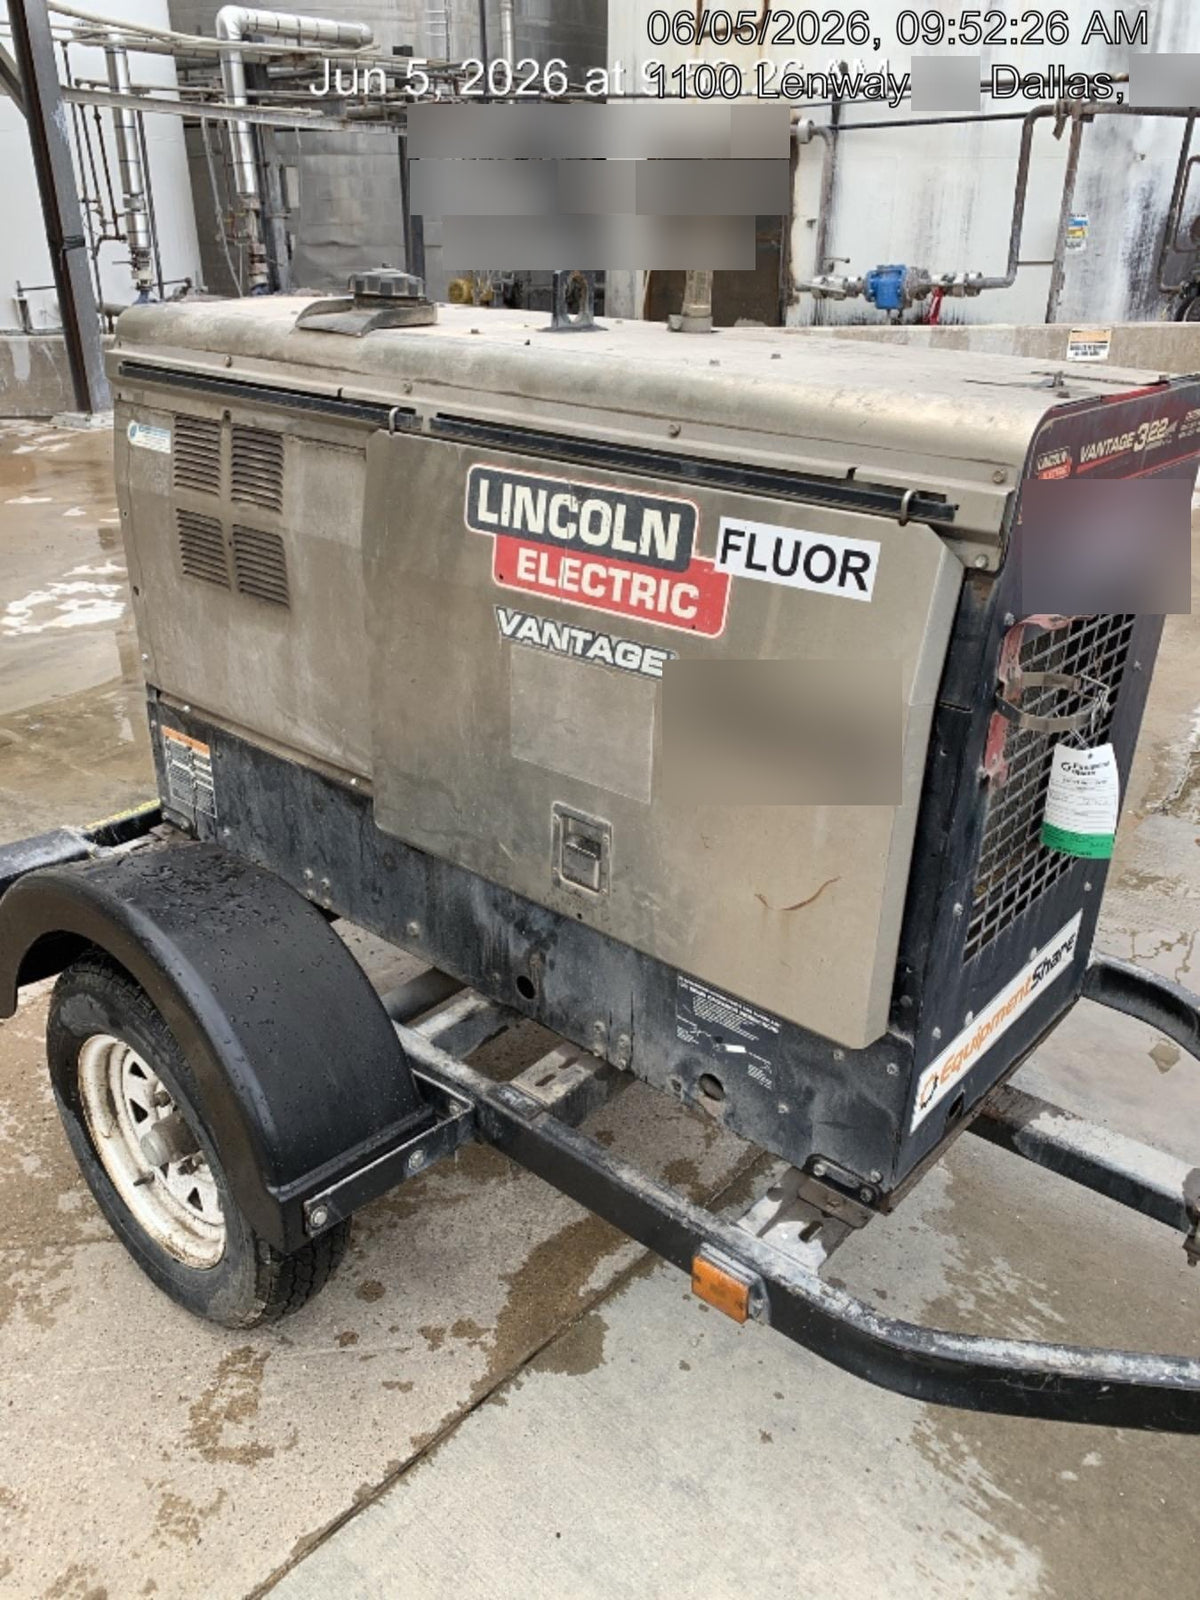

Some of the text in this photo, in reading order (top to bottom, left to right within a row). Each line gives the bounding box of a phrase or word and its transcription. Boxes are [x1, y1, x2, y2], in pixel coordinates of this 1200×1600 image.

[1079, 431, 1137, 463] VANTAGE
[477, 478, 681, 562] LINCOLN
[516, 547, 700, 620] ELECTRIC
[719, 528, 872, 592] FLUOR
[497, 608, 668, 676] VANTAGE
